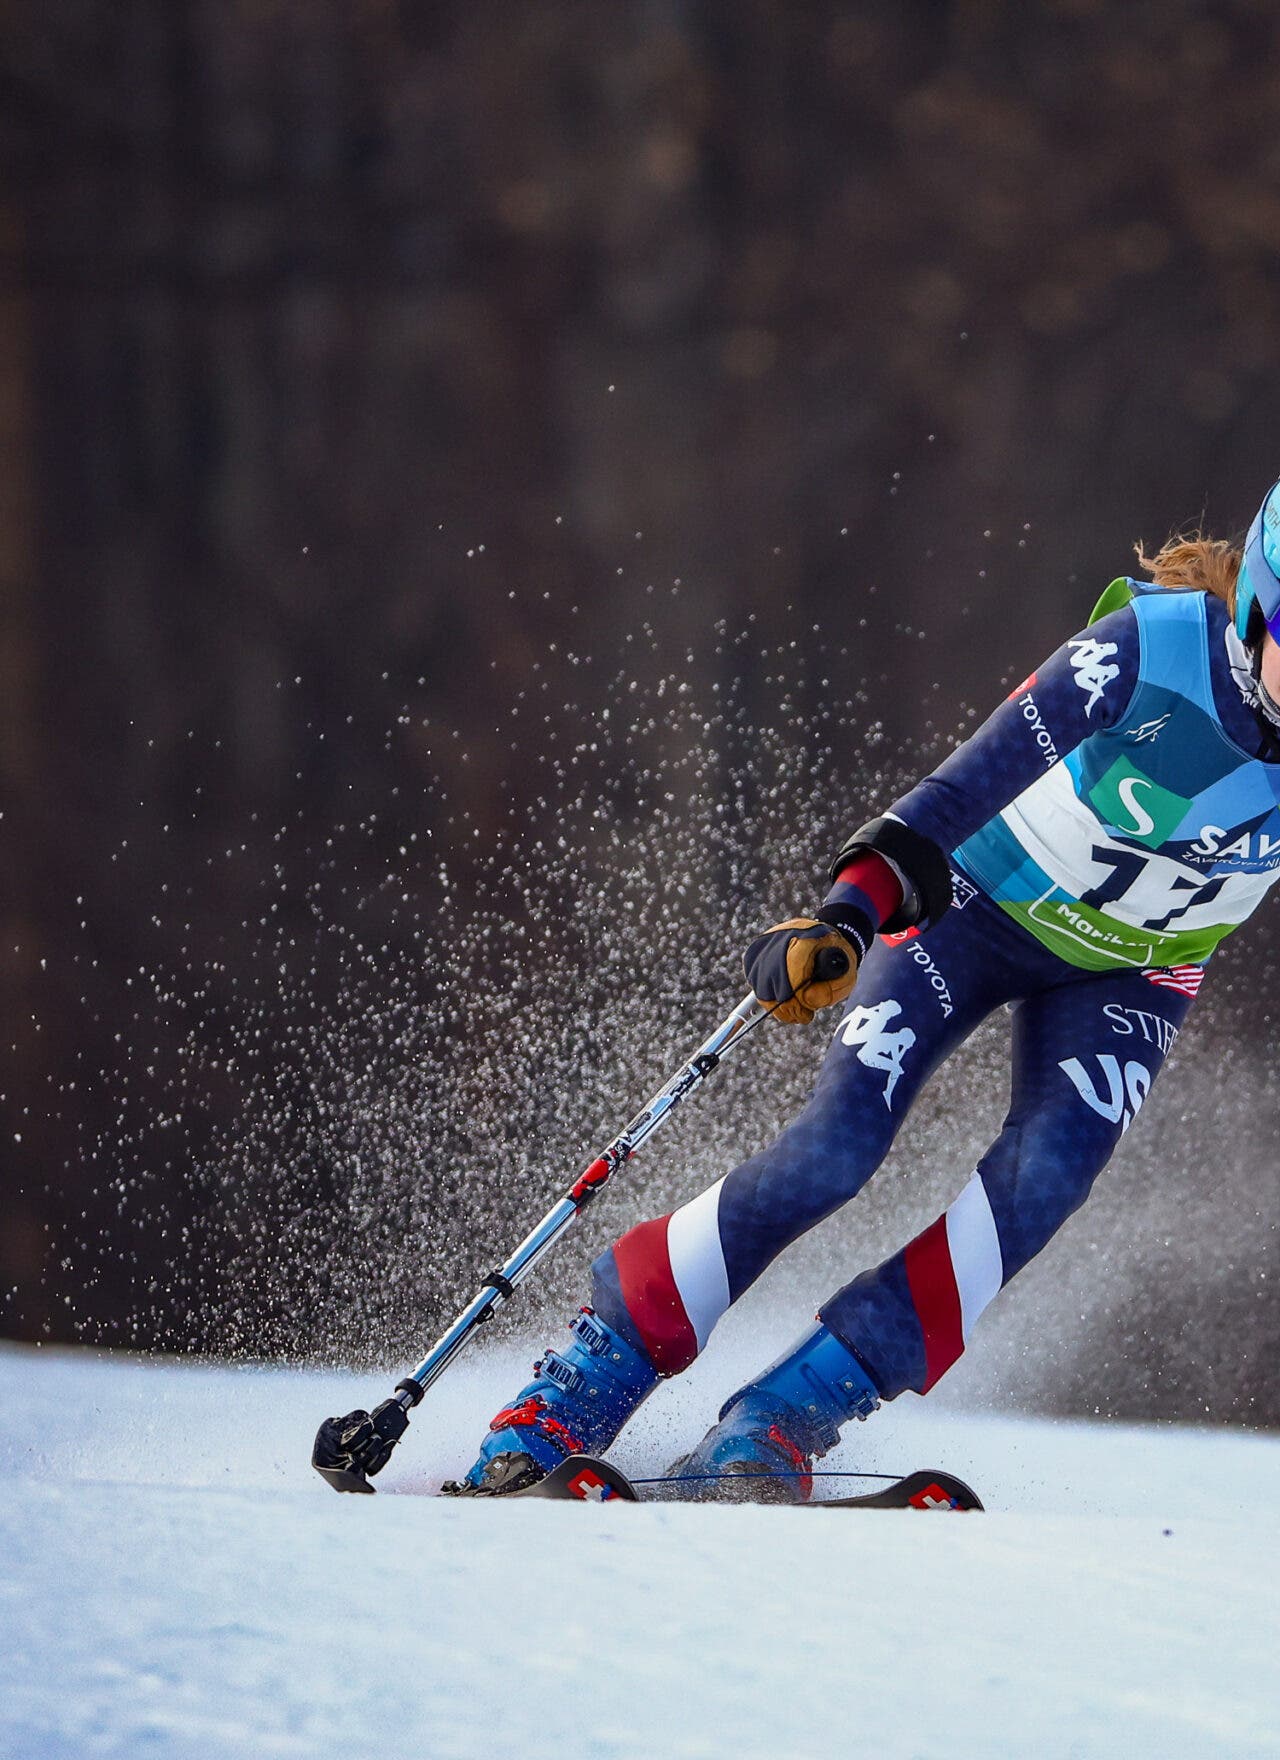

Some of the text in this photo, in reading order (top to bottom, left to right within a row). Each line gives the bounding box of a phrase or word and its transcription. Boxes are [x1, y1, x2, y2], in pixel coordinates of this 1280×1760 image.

[1019, 692, 1059, 767] TOYOTA
[1118, 777, 1155, 836] S
[1056, 903, 1147, 947] Marib
[906, 941, 954, 1019] TOYOTA
